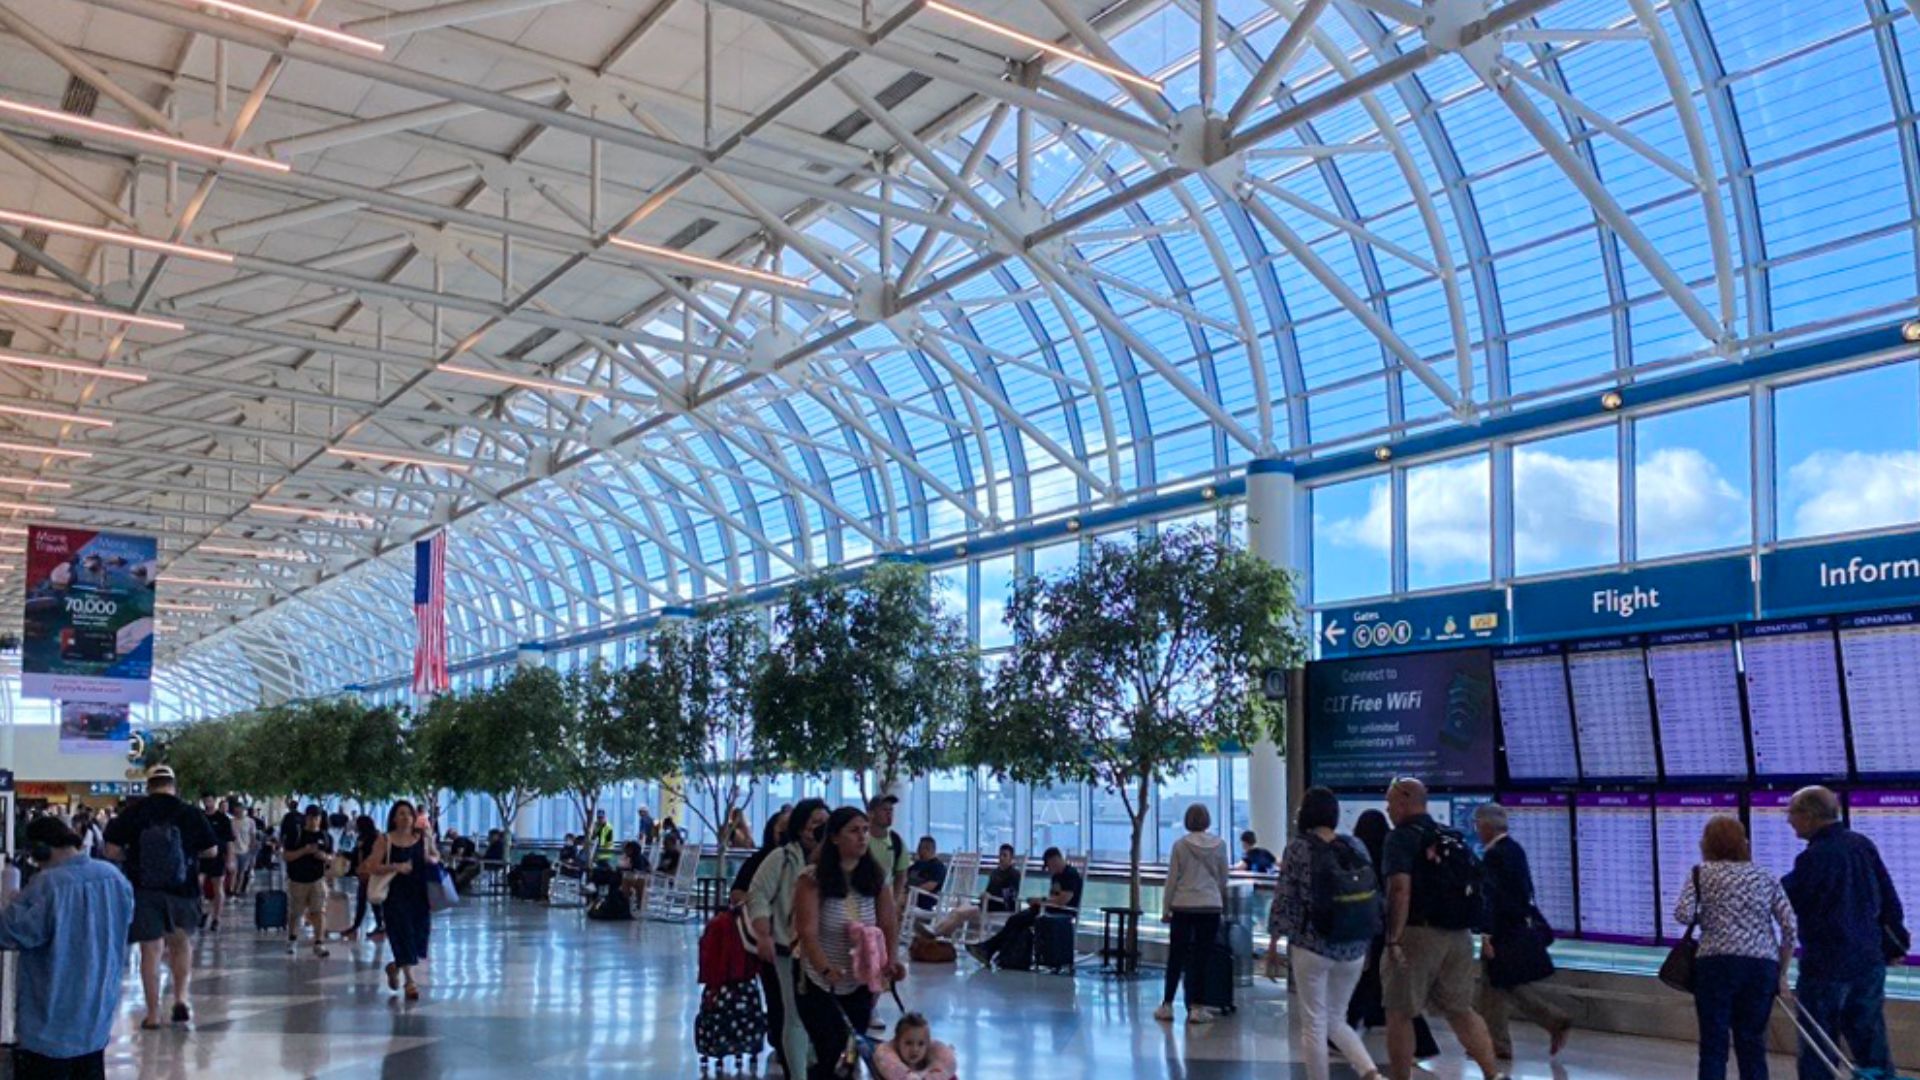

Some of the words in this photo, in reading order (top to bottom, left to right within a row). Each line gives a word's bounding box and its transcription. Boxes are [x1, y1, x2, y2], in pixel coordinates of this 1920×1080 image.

[1820, 556, 1920, 587] Inform
[64, 597, 118, 615] 70,000
[1593, 585, 1660, 617] Flight
[1353, 611, 1380, 622] Gates
[1342, 669, 1385, 684] Connect
[1386, 668, 1398, 680] to
[1351, 693, 1382, 712] Free
[1387, 690, 1423, 711] WiFi
